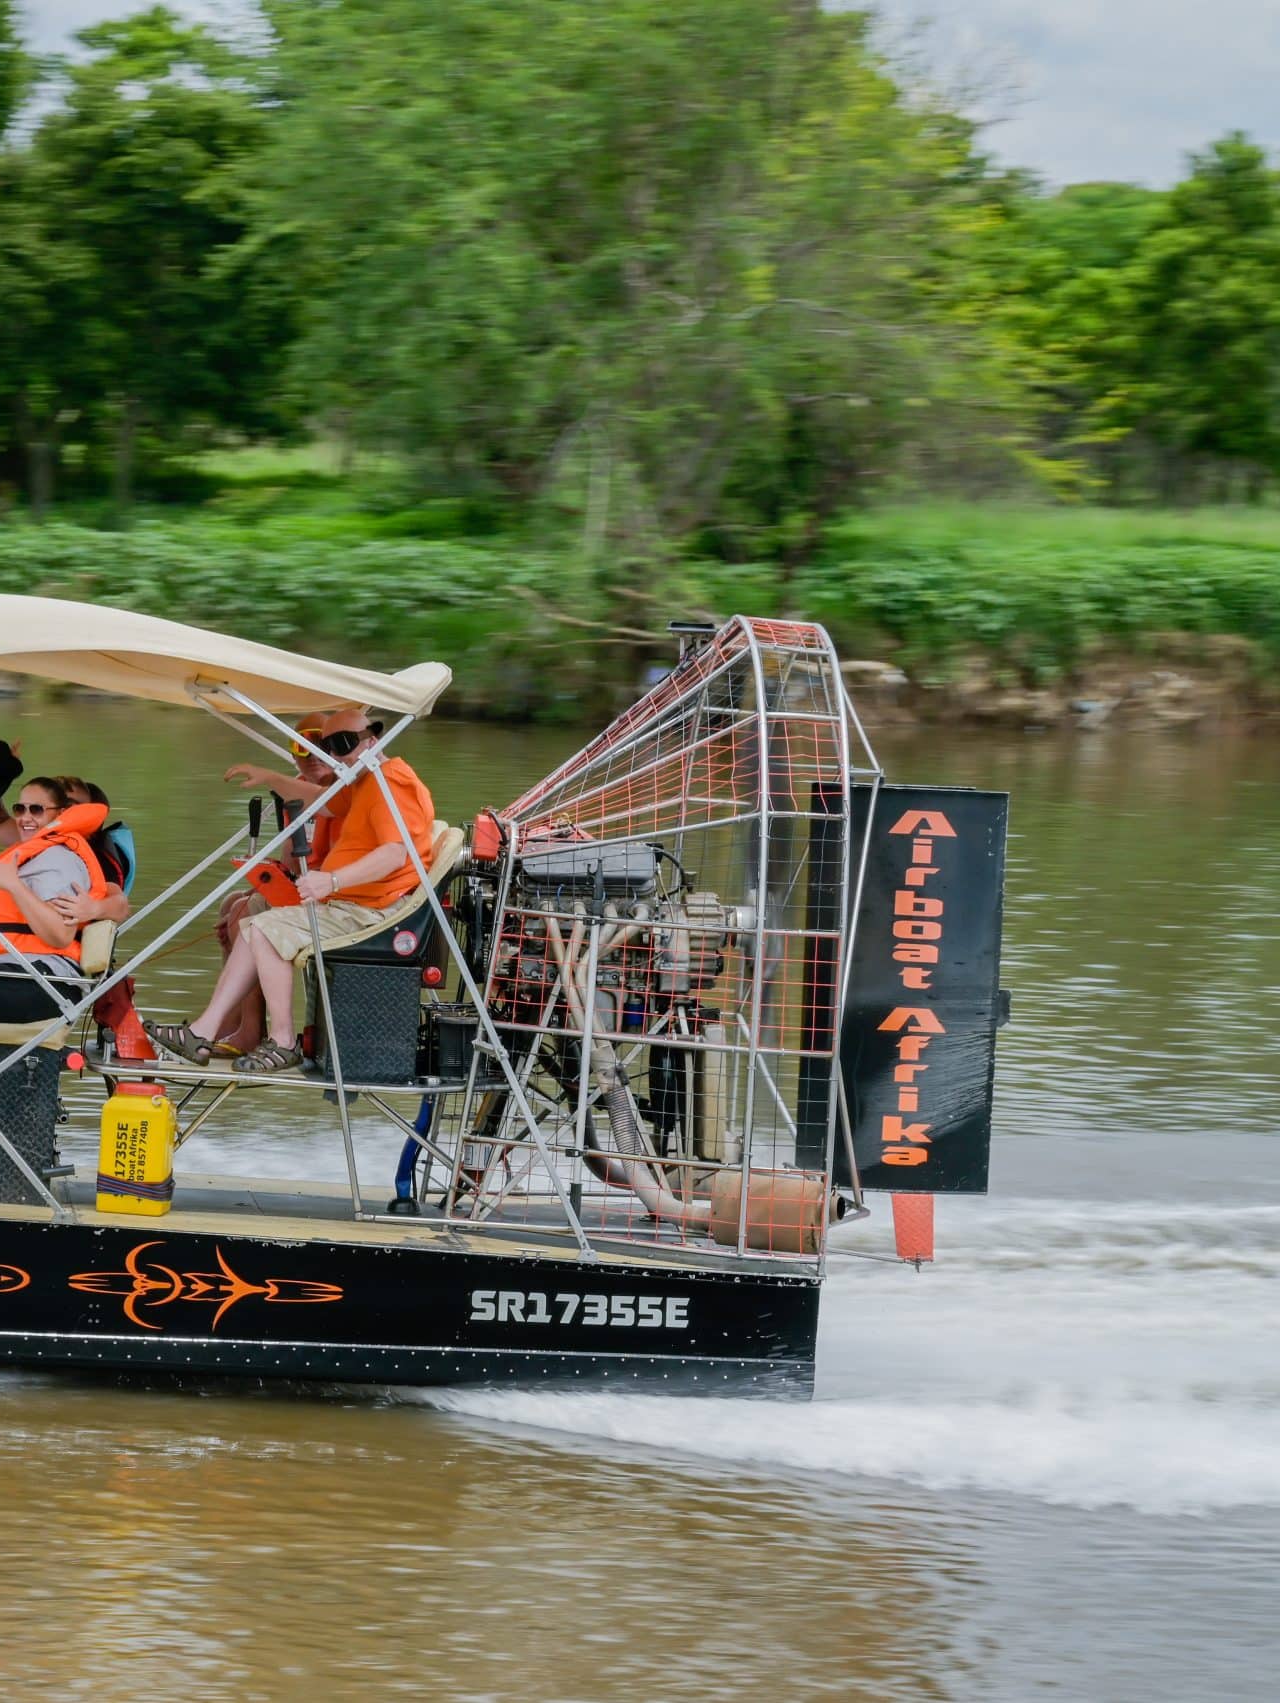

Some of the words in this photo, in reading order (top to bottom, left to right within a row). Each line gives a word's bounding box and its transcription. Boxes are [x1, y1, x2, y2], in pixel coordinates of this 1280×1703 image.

[888, 809, 958, 990] Airboat
[876, 1006, 946, 1167] Afrika
[129, 1128, 139, 1157] Afrika
[139, 1120, 149, 1146] 7408
[114, 1122, 129, 1198] 17355E
[138, 1147, 146, 1166] 857
[470, 1289, 690, 1329] SR17355E
